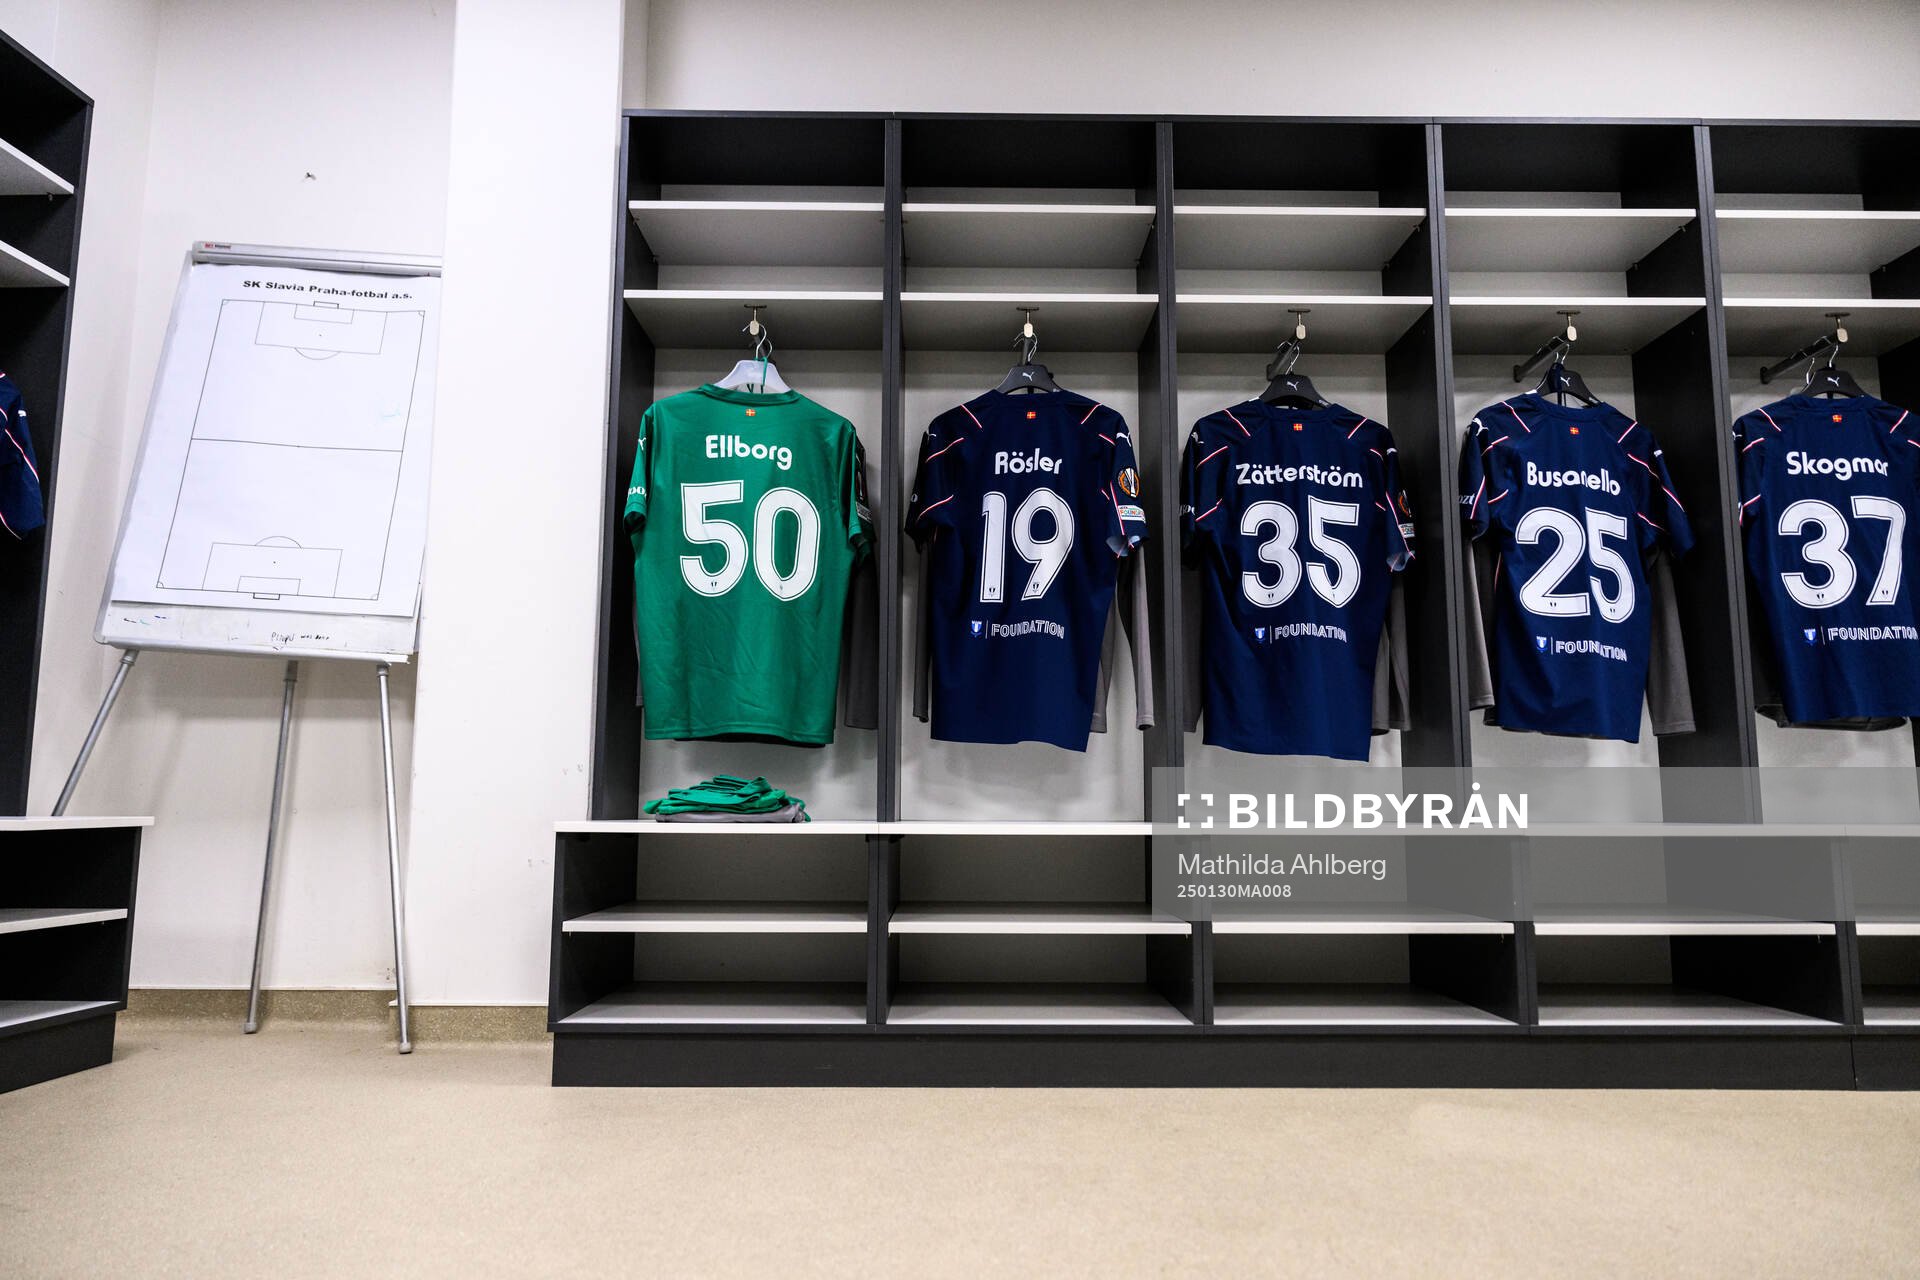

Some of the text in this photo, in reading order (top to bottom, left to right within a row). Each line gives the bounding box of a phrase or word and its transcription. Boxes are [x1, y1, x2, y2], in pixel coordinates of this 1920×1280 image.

[243, 280, 413, 300] SK Slavia Praha-fotbal a.s.
[705, 434, 793, 471] Ellborg
[994, 447, 1063, 475] Rösler
[1786, 450, 1889, 481] Skogmar
[1235, 463, 1364, 488] Zätterström
[1526, 461, 1621, 496] Busanello
[679, 479, 822, 602] 50
[979, 487, 1075, 603] 19
[1240, 494, 1362, 609] 35
[1777, 495, 1907, 609] 37
[1514, 506, 1636, 624] 25
[991, 619, 1065, 640] FOUNDATION
